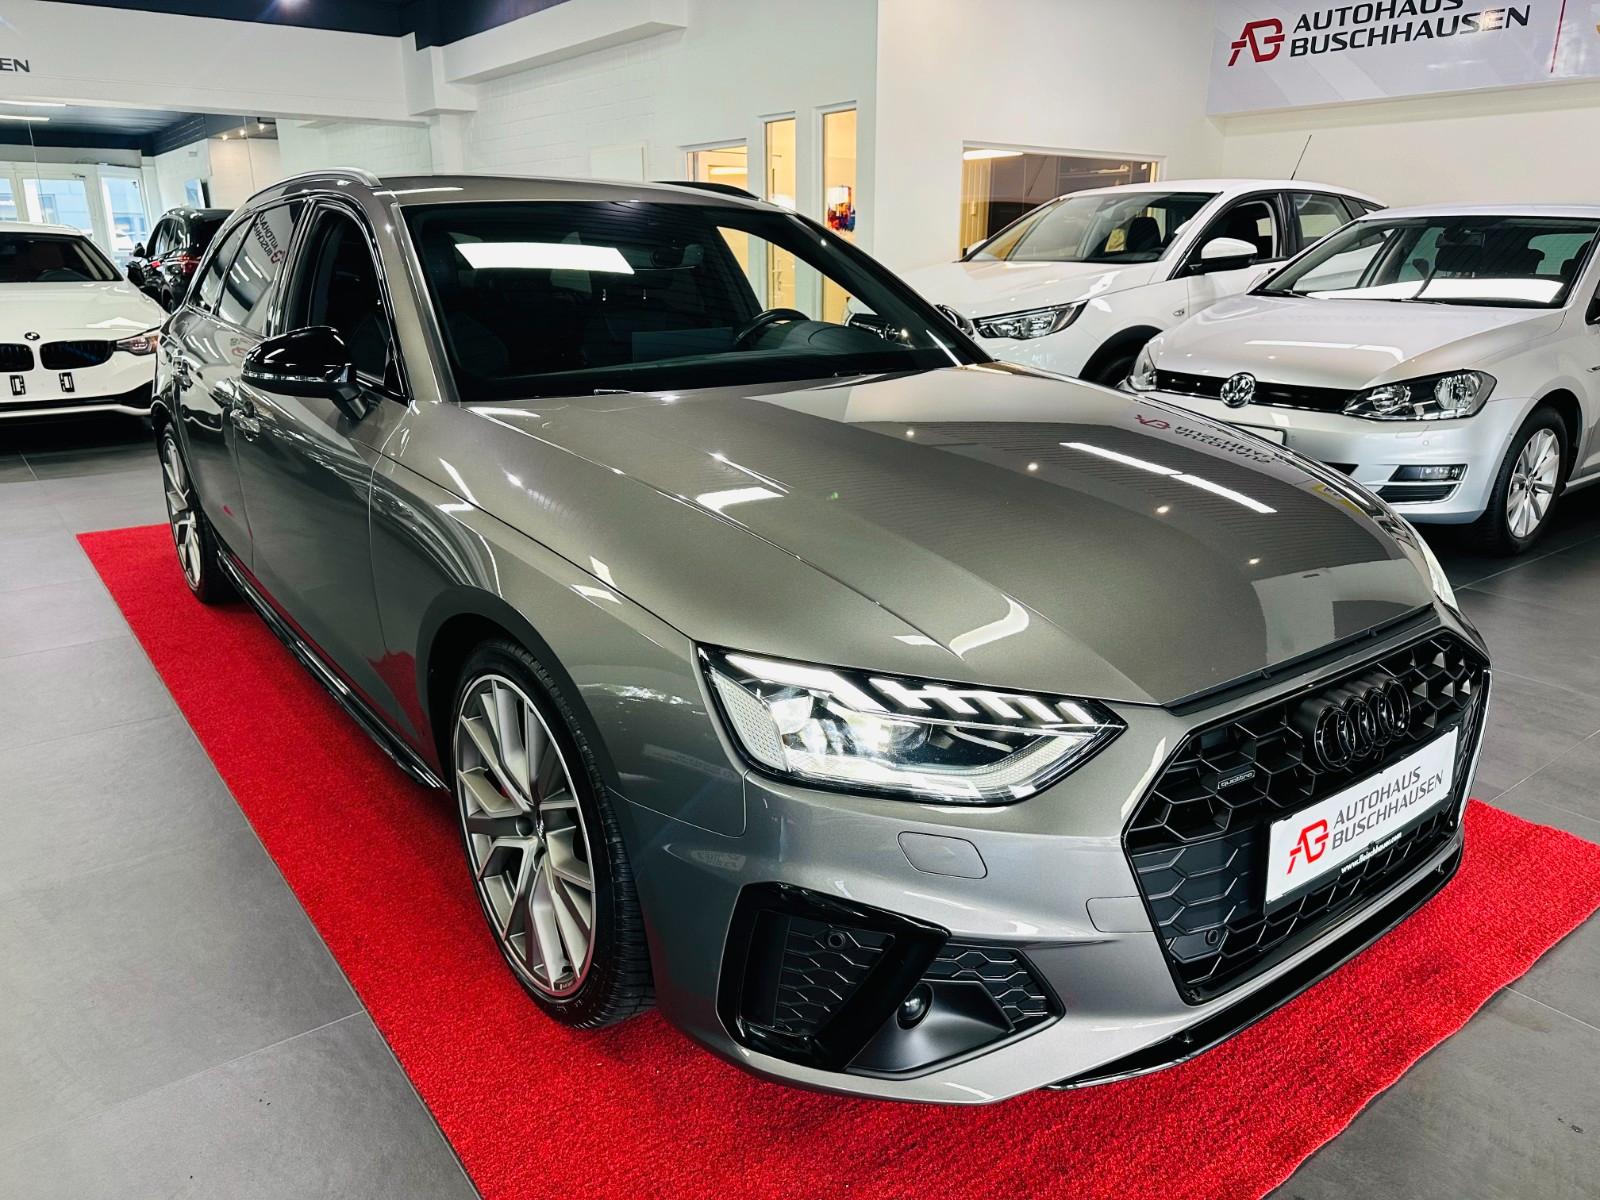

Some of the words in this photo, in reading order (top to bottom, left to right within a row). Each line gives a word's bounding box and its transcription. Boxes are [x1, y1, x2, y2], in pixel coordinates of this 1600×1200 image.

[1290, 4, 1530, 57] BUSCHHAUSEN
[1293, 0, 1463, 34] AUTOHAUS
[1332, 769, 1443, 850] BUSCHHAUSEN
[1333, 766, 1421, 829] AUTOHAUS
